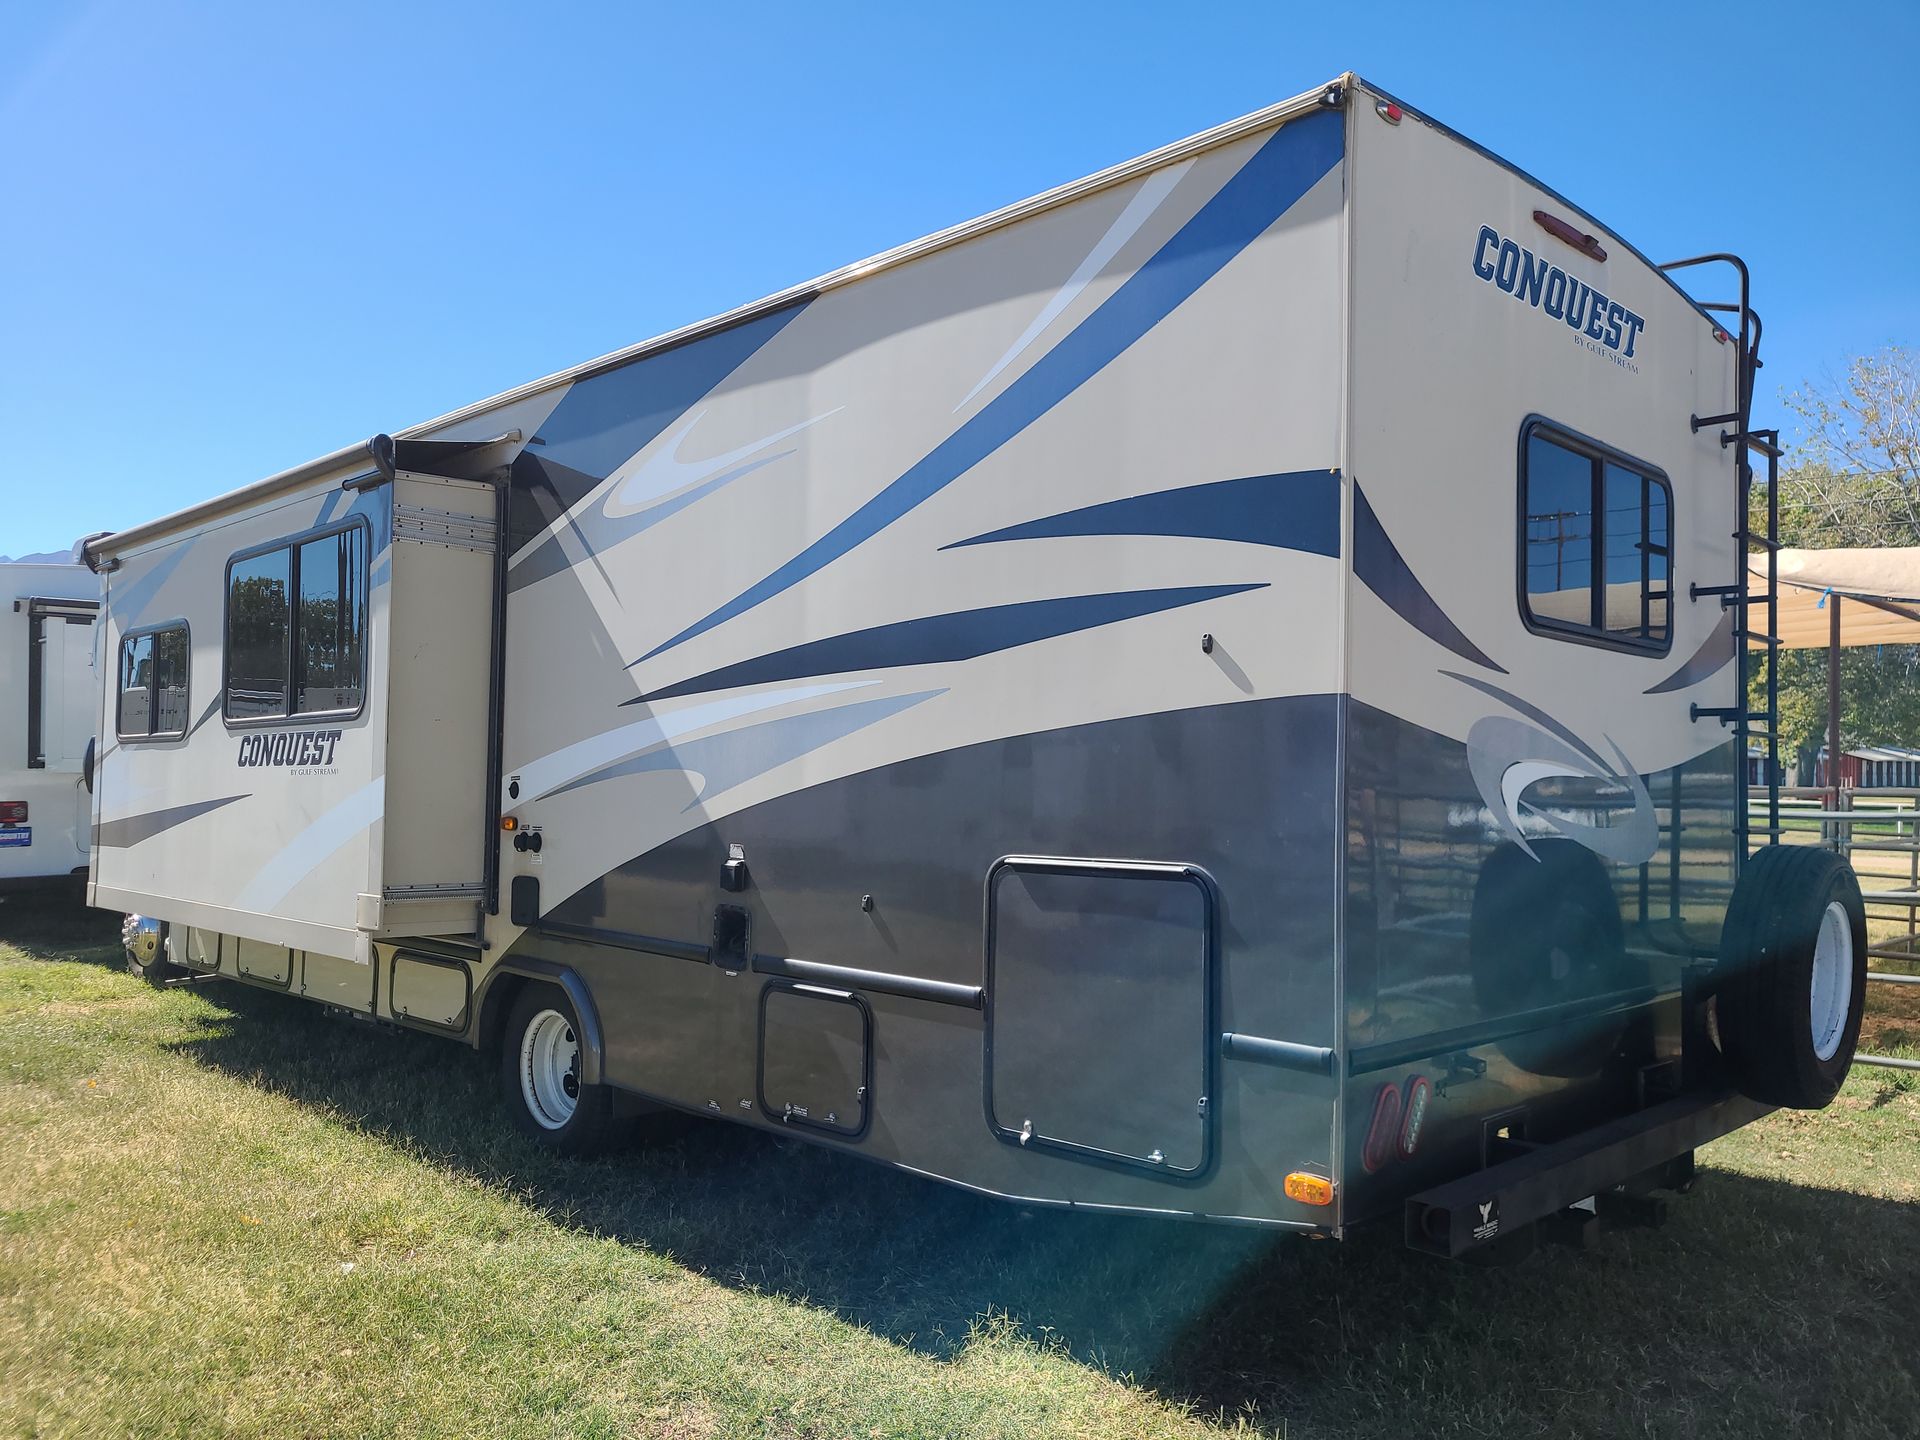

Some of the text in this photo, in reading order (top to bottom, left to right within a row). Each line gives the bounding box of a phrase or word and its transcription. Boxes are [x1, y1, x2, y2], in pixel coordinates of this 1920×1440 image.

[1472, 224, 1646, 359] CONQUEST
[1573, 334, 1640, 375] BY GULF STREAM
[237, 729, 342, 768] CONQUEST
